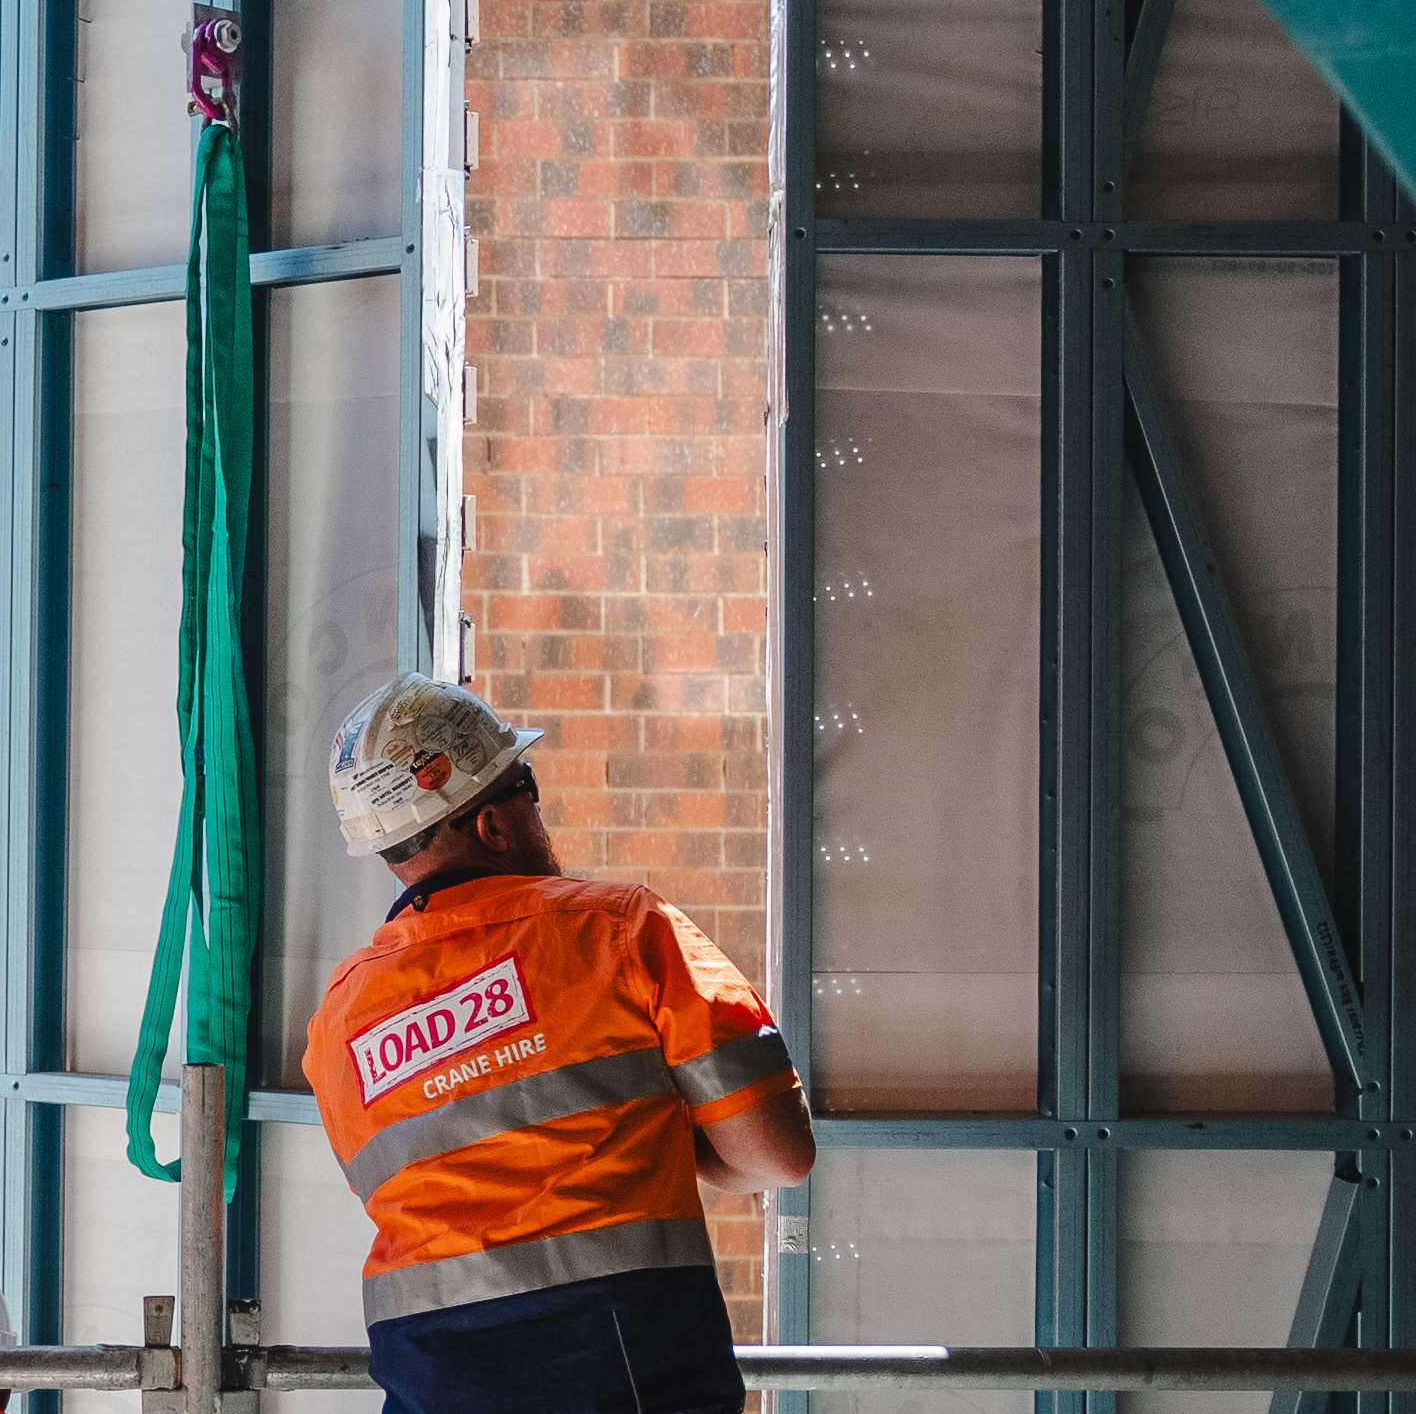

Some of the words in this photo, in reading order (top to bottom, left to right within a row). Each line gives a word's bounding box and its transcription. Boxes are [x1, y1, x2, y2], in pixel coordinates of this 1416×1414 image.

[365, 1009, 456, 1085] LOAD
[459, 978, 515, 1034] 28
[423, 1055, 492, 1099] CRANE
[494, 1032, 547, 1068] HIRE
